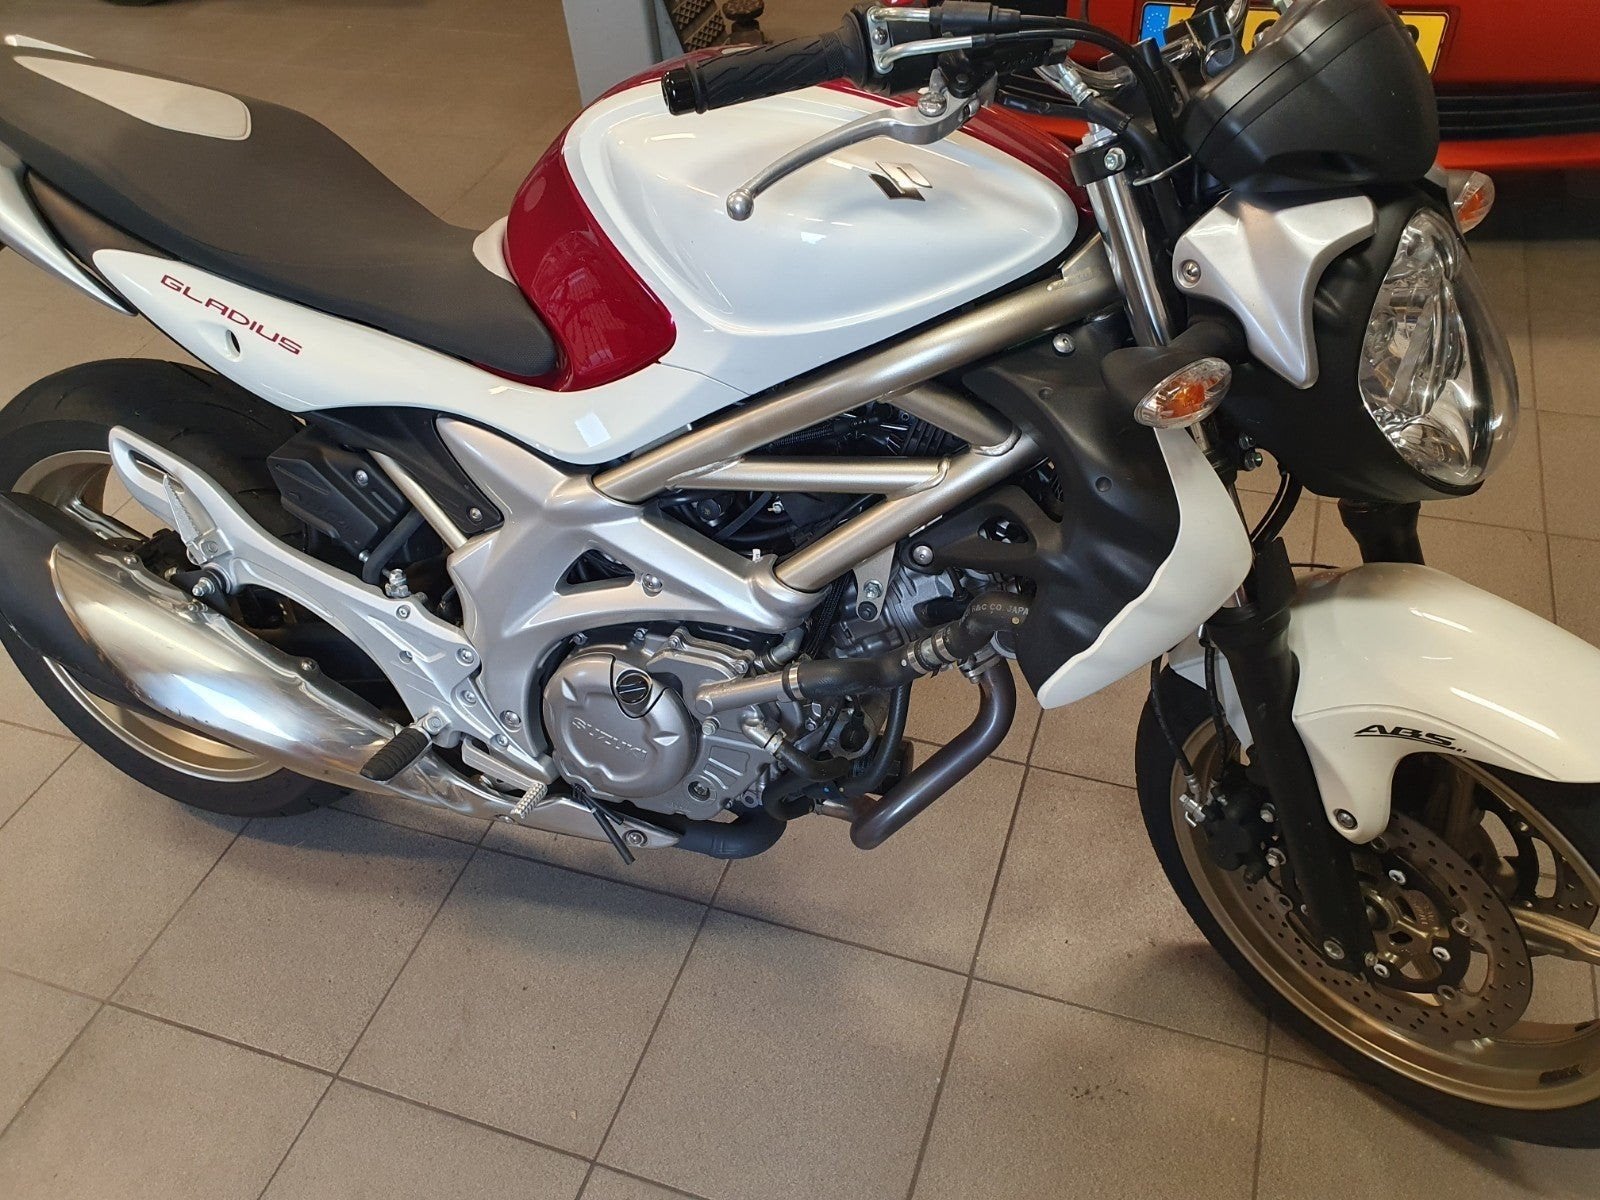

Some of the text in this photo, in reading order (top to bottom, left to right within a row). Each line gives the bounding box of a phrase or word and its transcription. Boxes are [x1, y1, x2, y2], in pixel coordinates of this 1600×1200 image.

[160, 273, 303, 356] GLADIUS
[1006, 605, 1029, 616] JAPA
[1354, 723, 1457, 748] ABS
